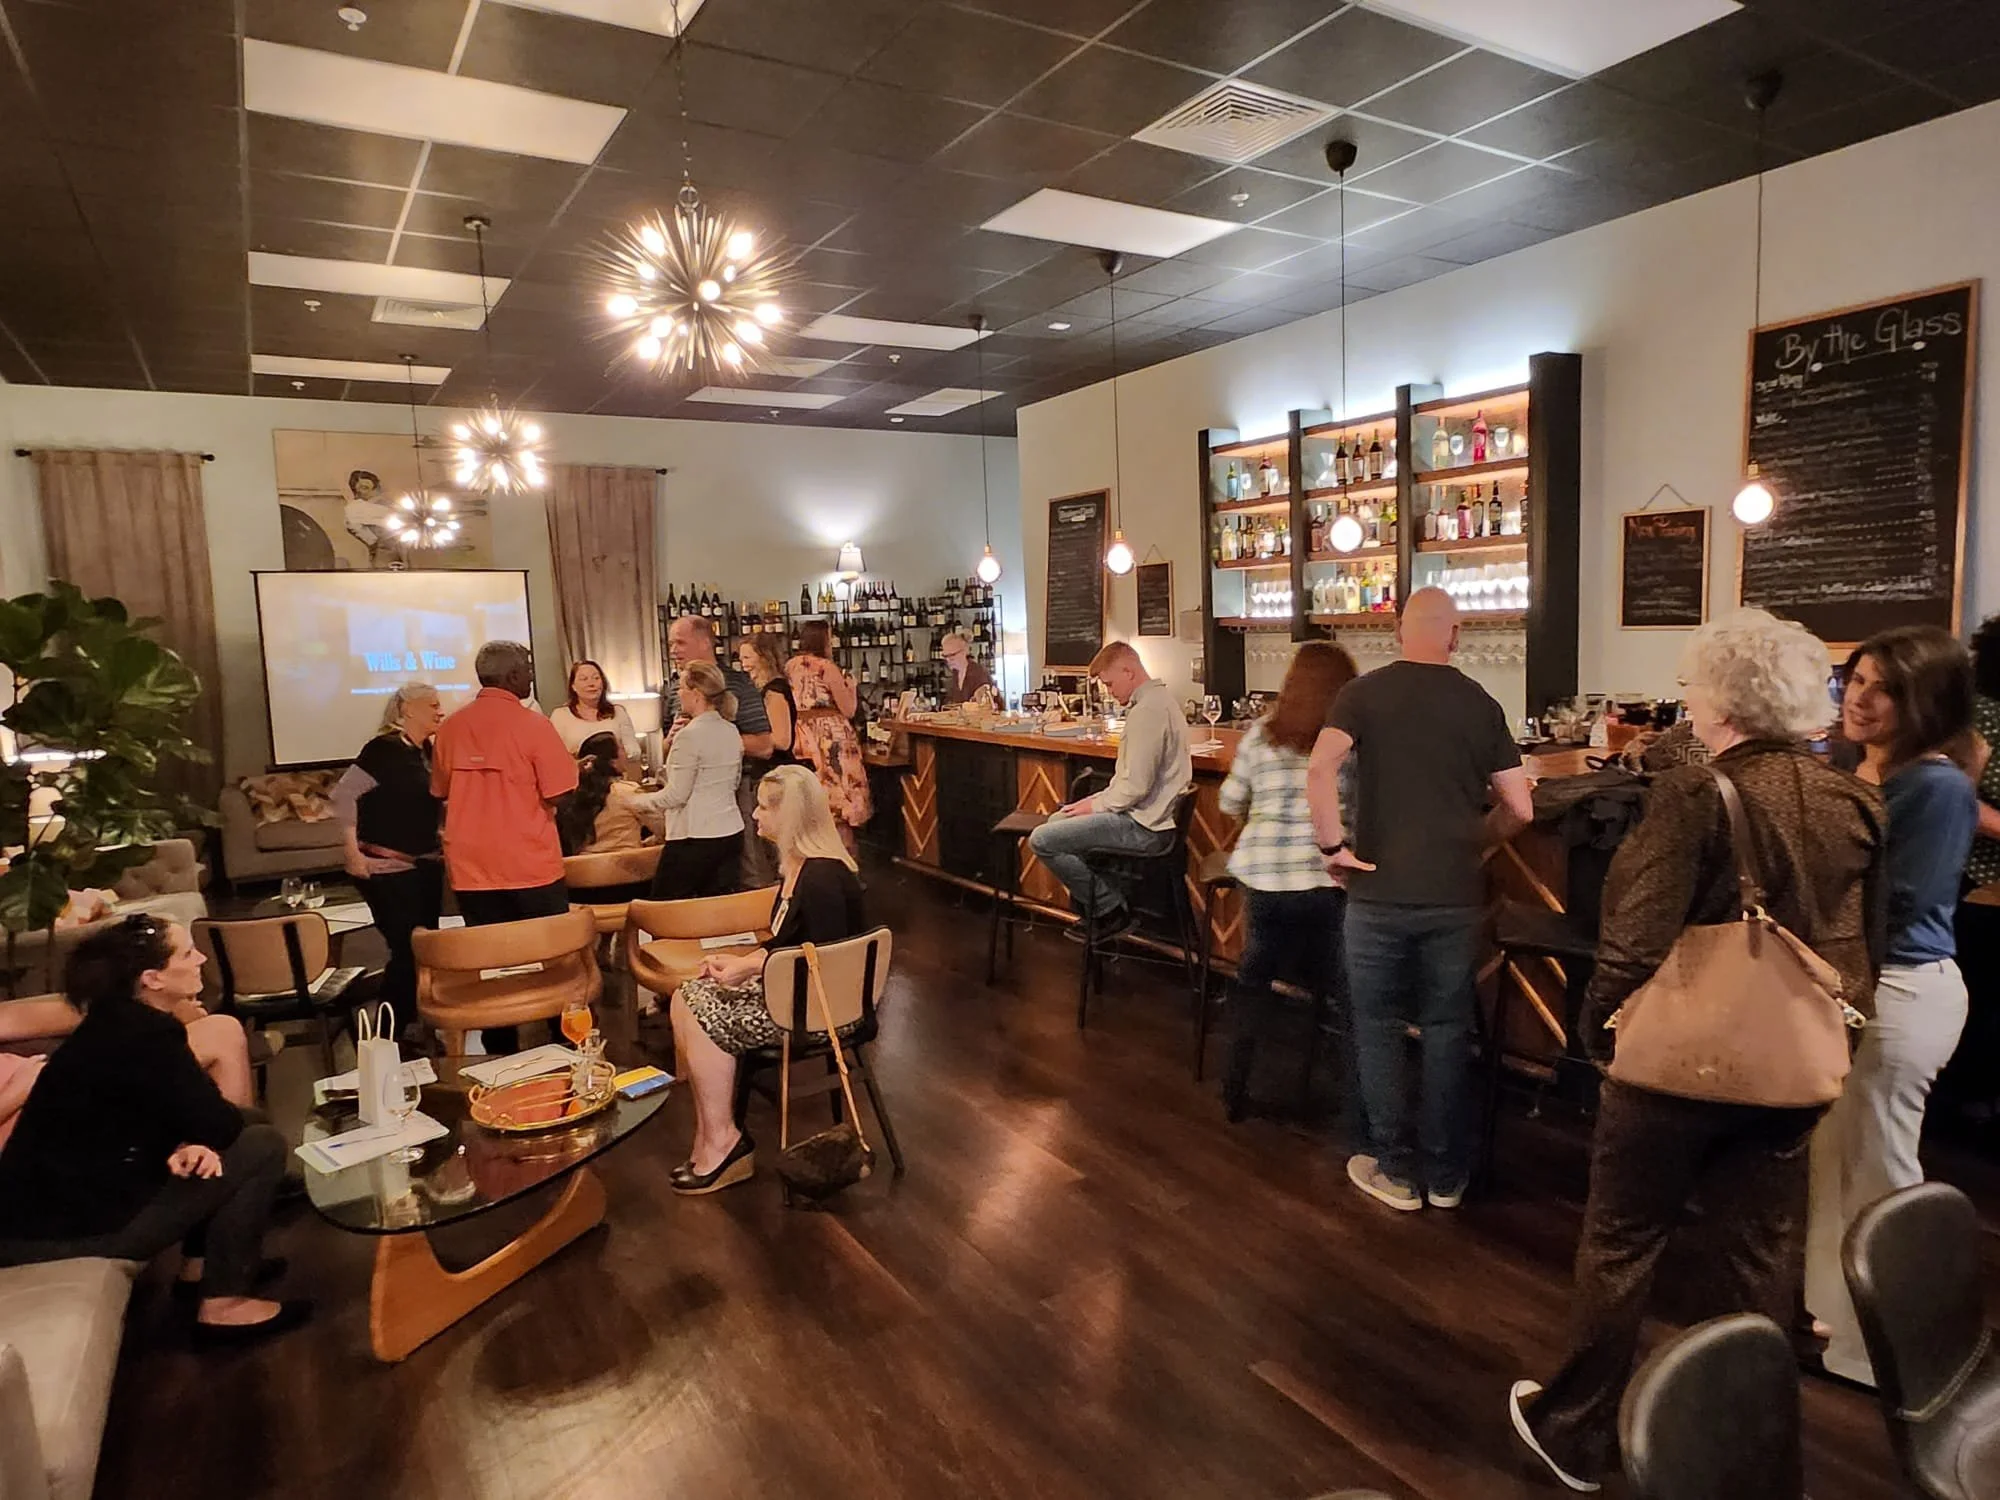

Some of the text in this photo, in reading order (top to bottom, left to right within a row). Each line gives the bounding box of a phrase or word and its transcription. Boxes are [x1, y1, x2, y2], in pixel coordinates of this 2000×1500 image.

[1775, 333, 1819, 381] By
[1875, 308, 1962, 352] Glass
[420, 650, 456, 671] Wine
